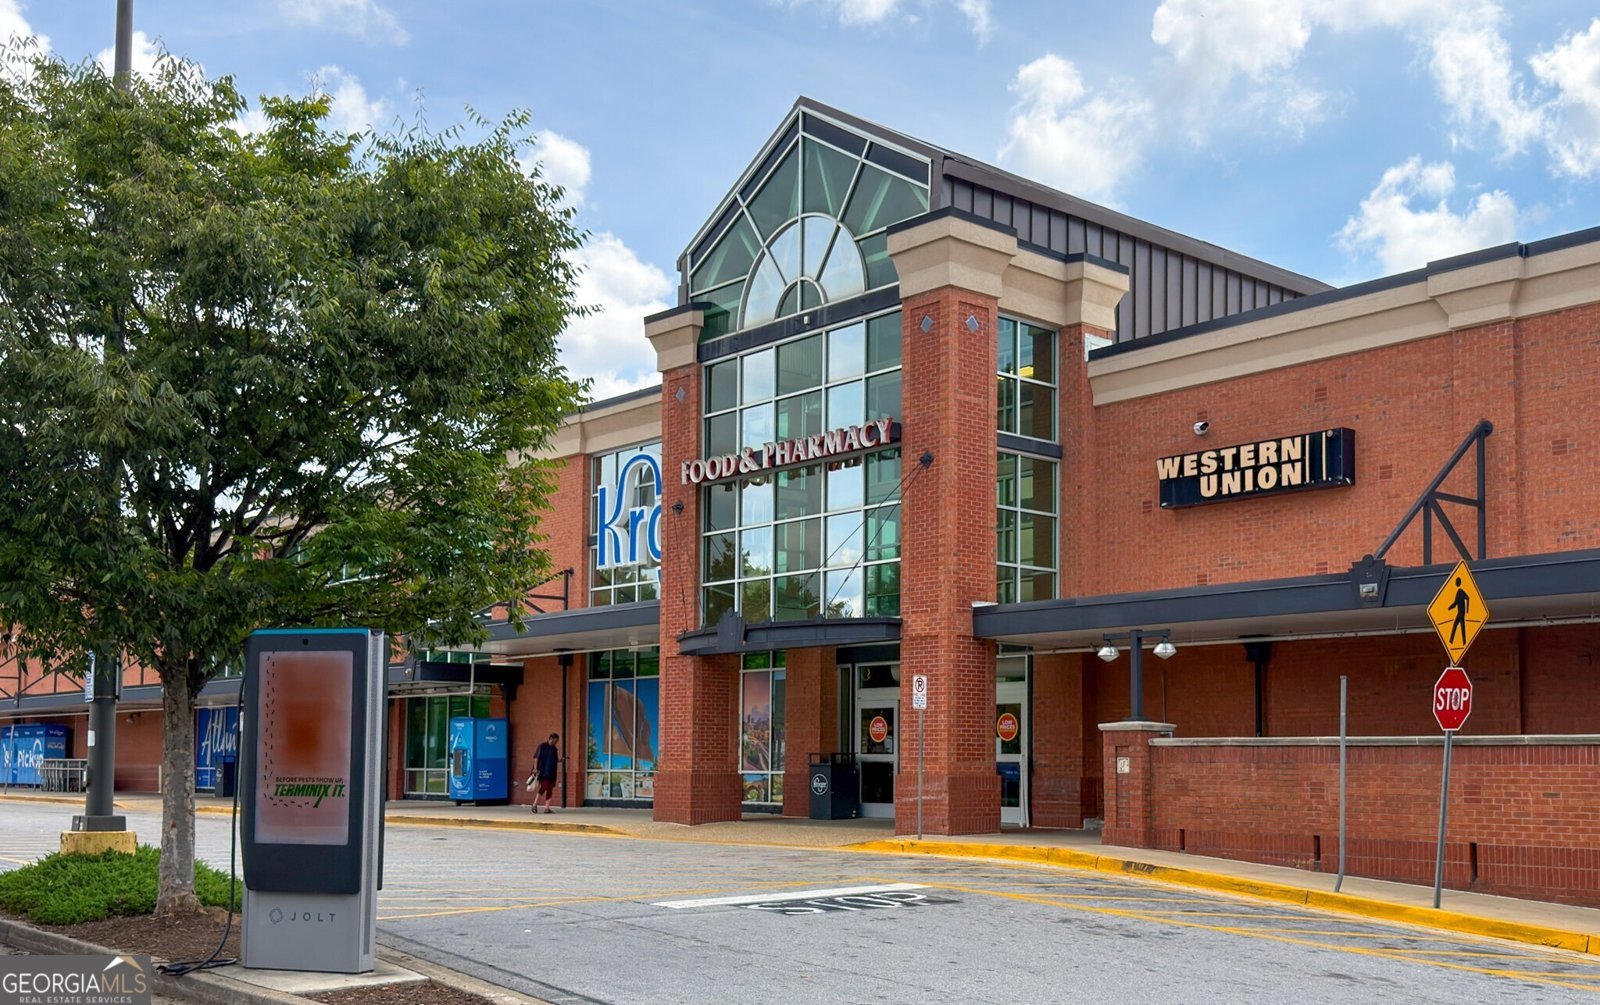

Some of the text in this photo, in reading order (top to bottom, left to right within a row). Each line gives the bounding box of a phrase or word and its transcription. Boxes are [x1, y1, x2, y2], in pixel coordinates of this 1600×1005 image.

[681, 417, 893, 485] FOOD & PHARMACY
[1156, 435, 1302, 480] WESTERN
[1200, 461, 1302, 498] UNION
[1436, 688, 1469, 710] STOP
[274, 784, 345, 808] TERMINIX IT.
[741, 890, 931, 915] STOP
[291, 912, 336, 922] JOLT
